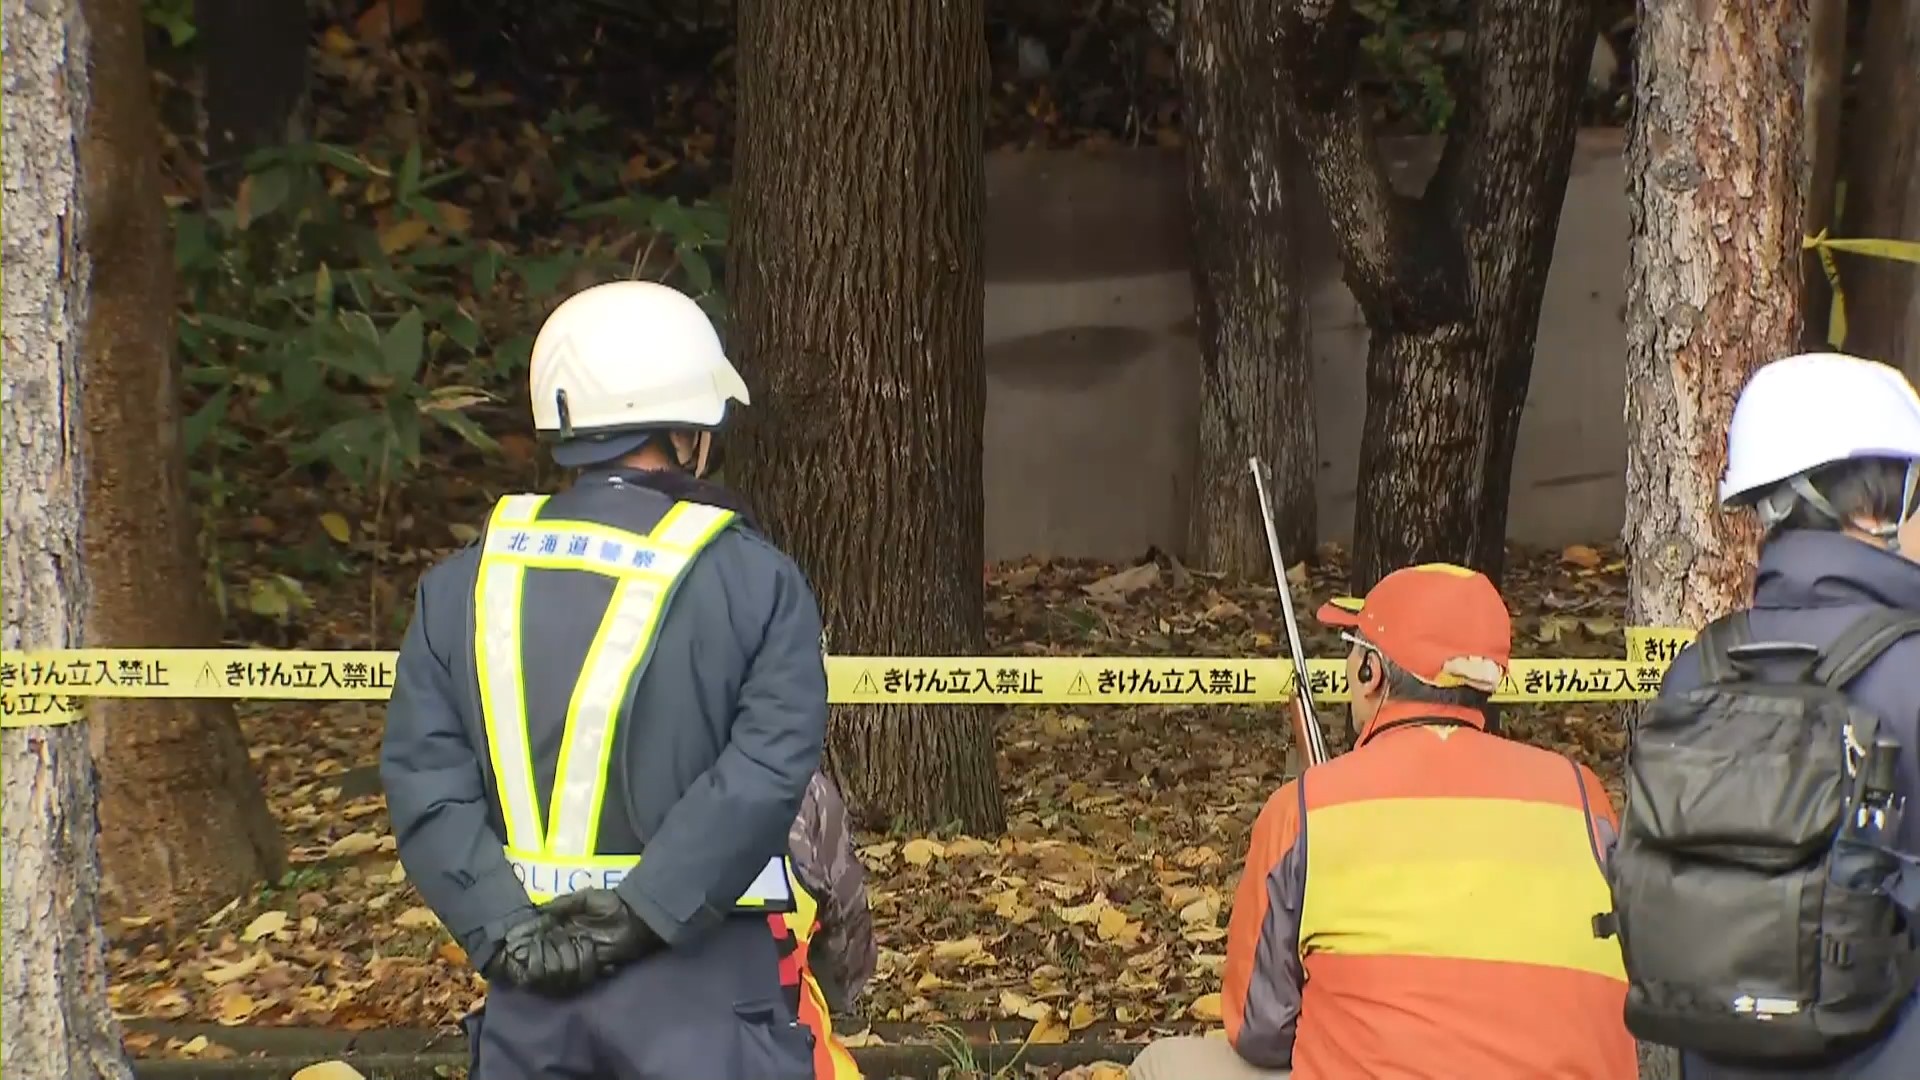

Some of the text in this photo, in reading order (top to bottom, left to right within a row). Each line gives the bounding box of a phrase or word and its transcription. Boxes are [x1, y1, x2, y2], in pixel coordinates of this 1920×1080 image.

[508, 531, 656, 568] 北海道察
[1645, 637, 1690, 662] きけ
[1, 660, 169, 687] きけん立入禁止
[226, 661, 393, 689] きけん立入禁止
[884, 668, 1043, 694] きけん立入禁止
[1098, 669, 1256, 695] きけん立入禁止
[512, 863, 623, 892] OLICE
